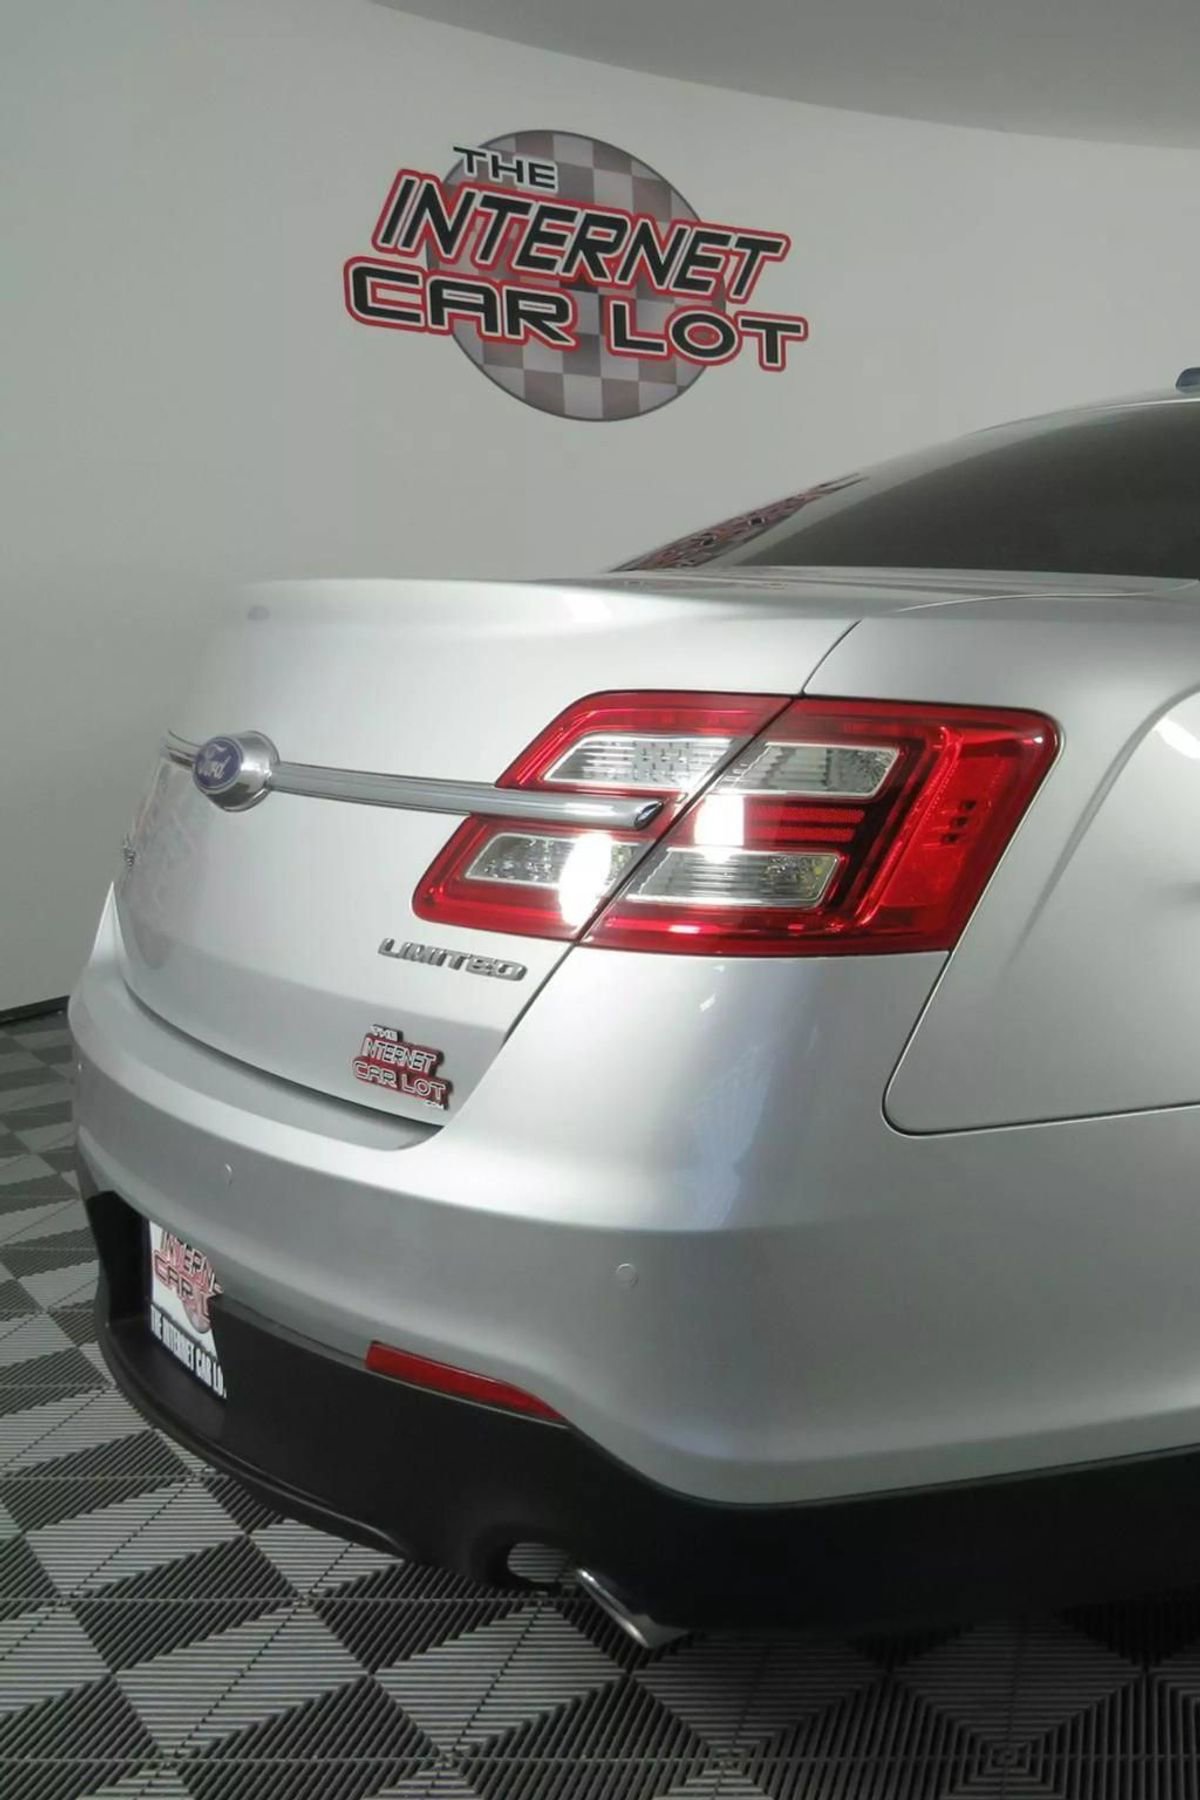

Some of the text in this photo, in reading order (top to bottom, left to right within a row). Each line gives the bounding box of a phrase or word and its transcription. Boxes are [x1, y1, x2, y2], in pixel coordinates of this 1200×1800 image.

[453, 146, 557, 191] THE
[374, 172, 788, 300] INTERNET
[348, 260, 804, 367] CAR LOT
[378, 938, 527, 981] LIMITED
[361, 1037, 438, 1074] INTERNET
[353, 1060, 447, 1101] CAR LOT
[153, 1248, 195, 1300] CAR
